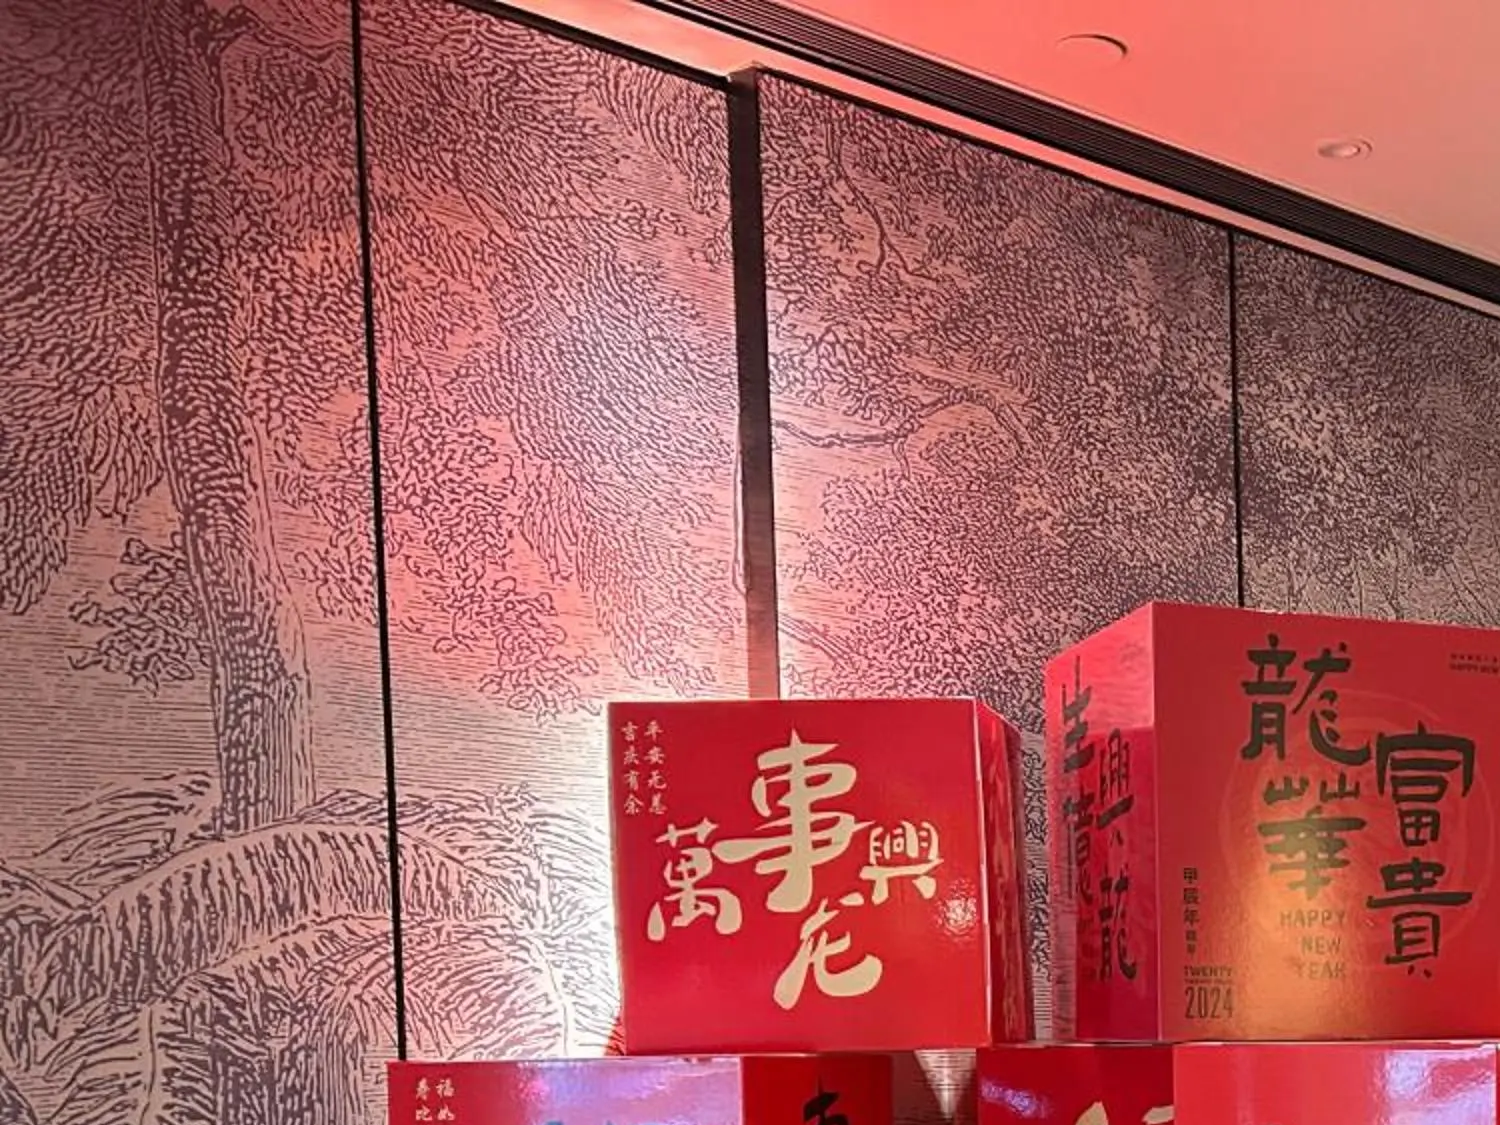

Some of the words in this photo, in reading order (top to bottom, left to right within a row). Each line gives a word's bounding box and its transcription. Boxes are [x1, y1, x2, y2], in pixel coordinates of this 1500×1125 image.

[1280, 909, 1345, 928] HAPPY
[1302, 936, 1341, 955] NEW
[1184, 965, 1233, 977] TWENTY
[1185, 986, 1233, 1019] 2024
